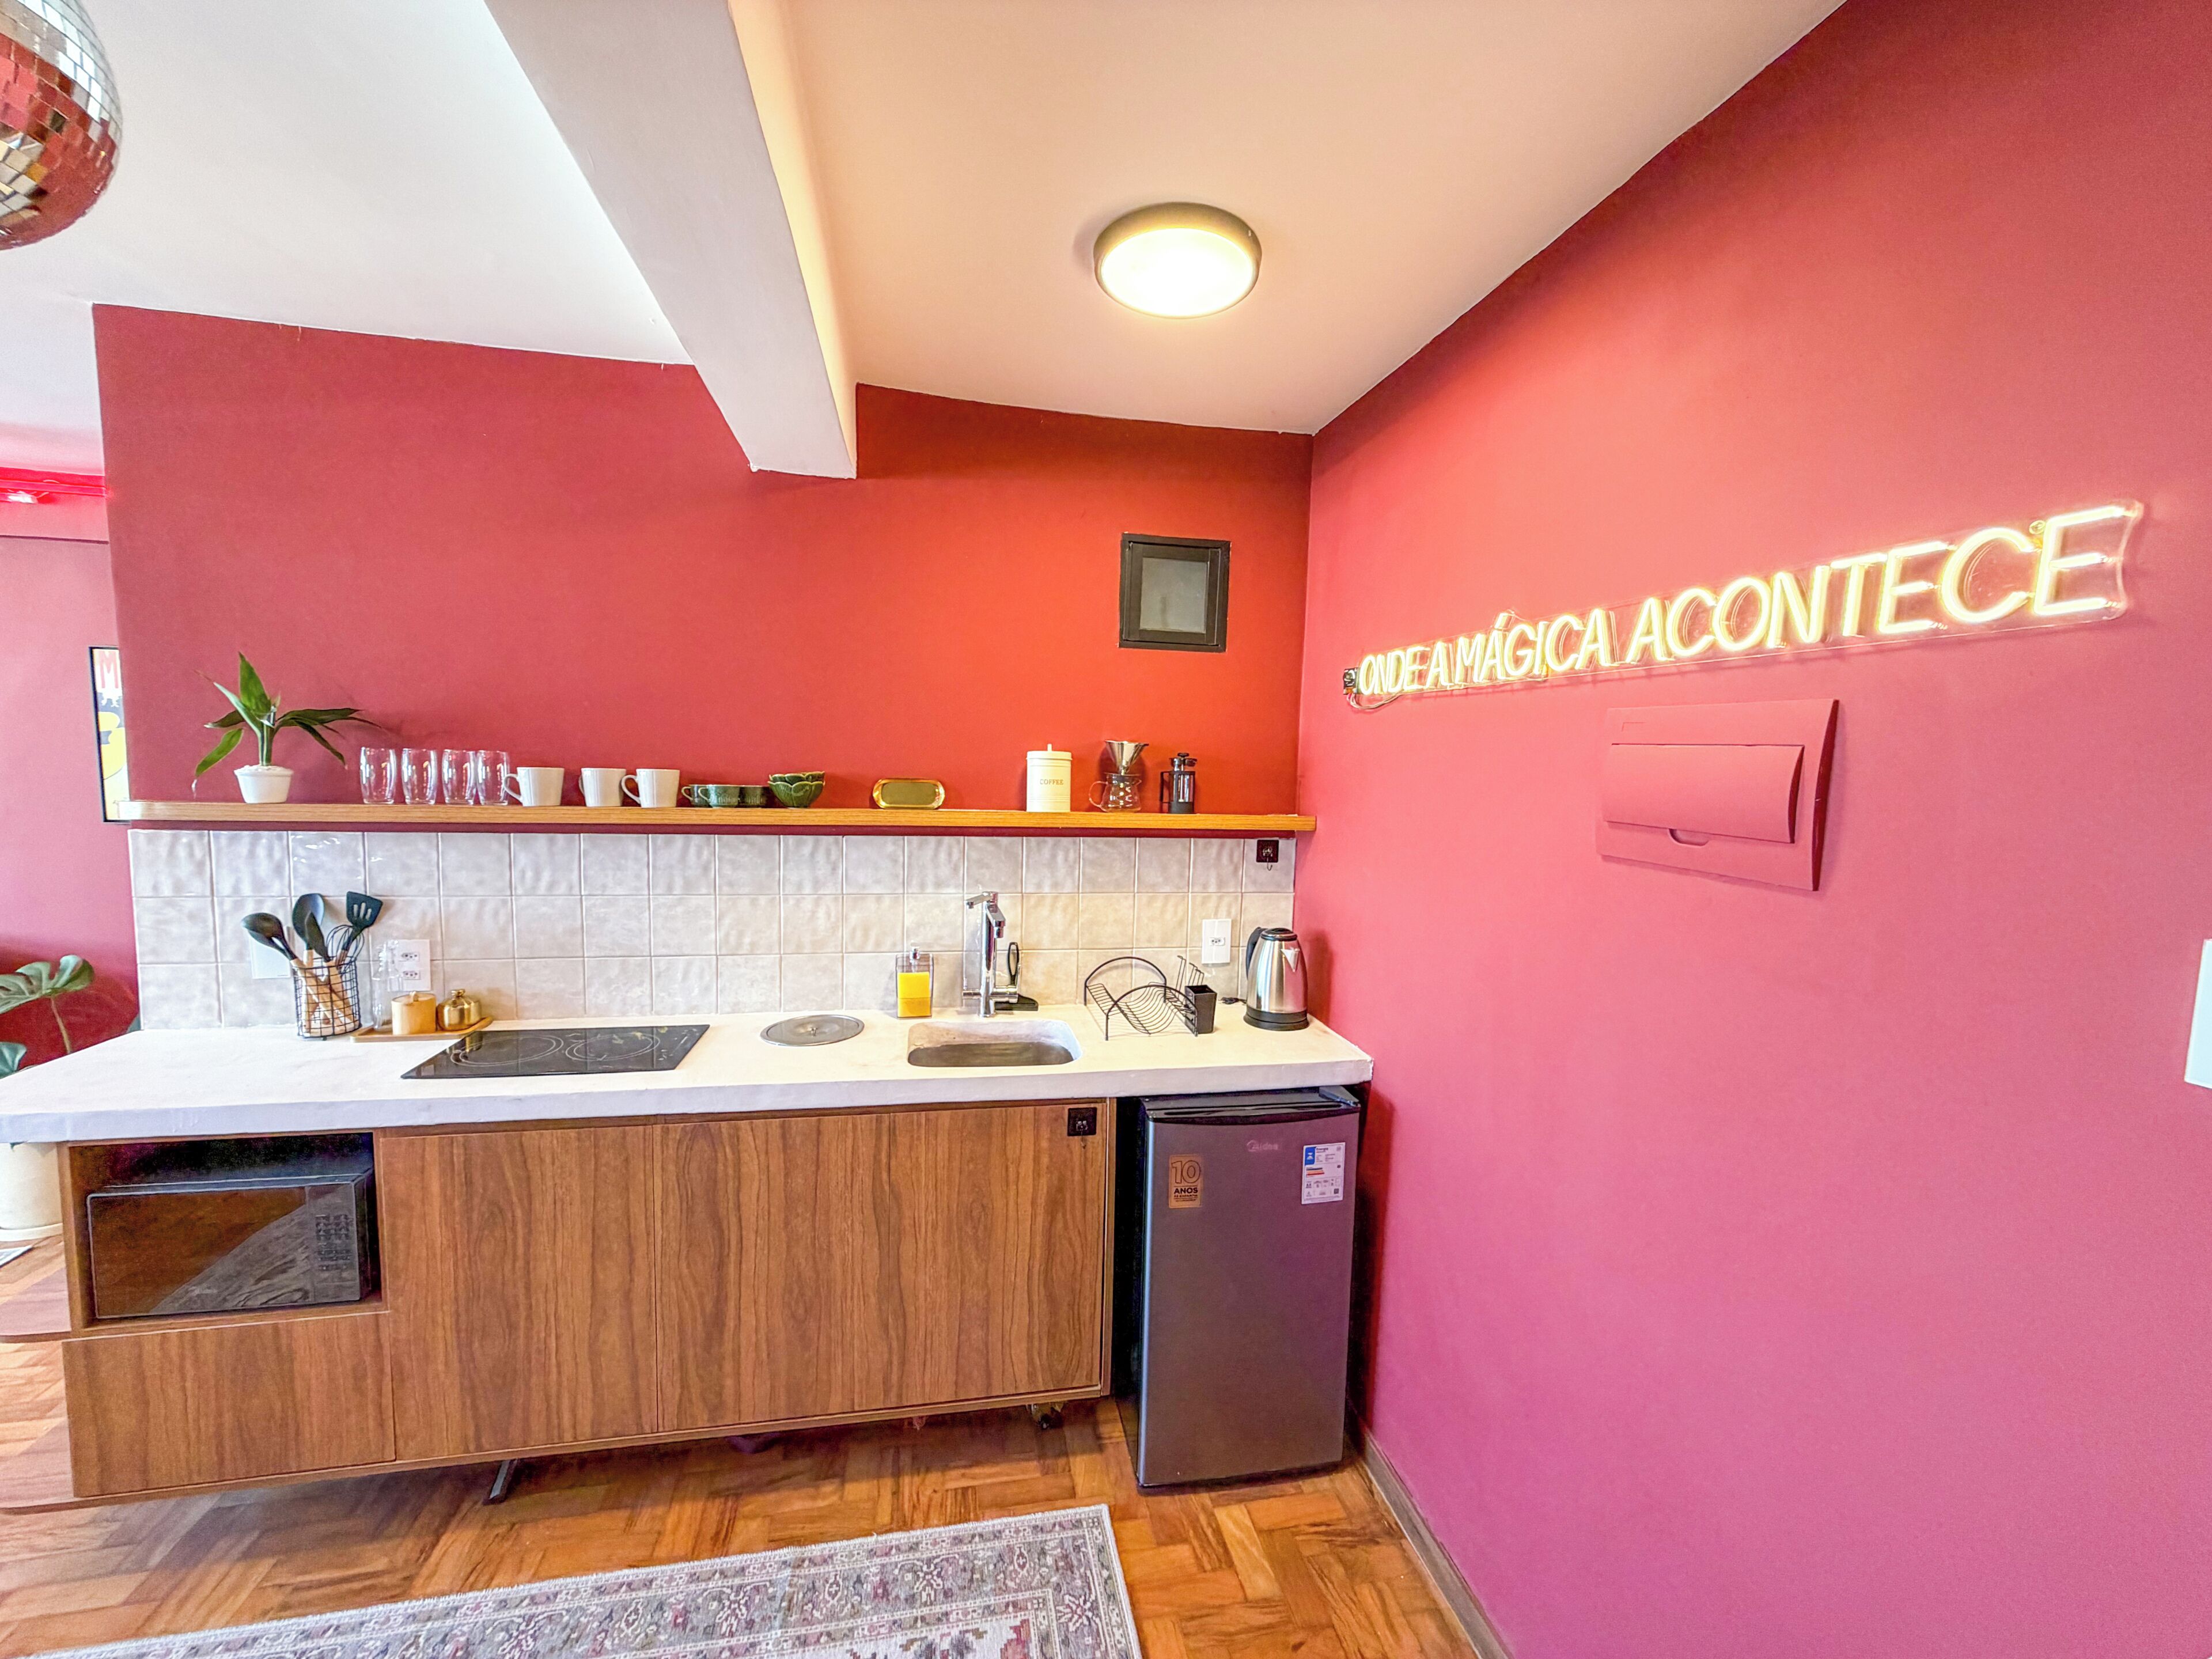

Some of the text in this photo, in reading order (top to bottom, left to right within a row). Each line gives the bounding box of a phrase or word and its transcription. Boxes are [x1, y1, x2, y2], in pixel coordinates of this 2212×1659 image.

[1359, 505, 2131, 696] ONDE A MÁGICA ACONTECE
[1171, 1160, 1201, 1184] 10
